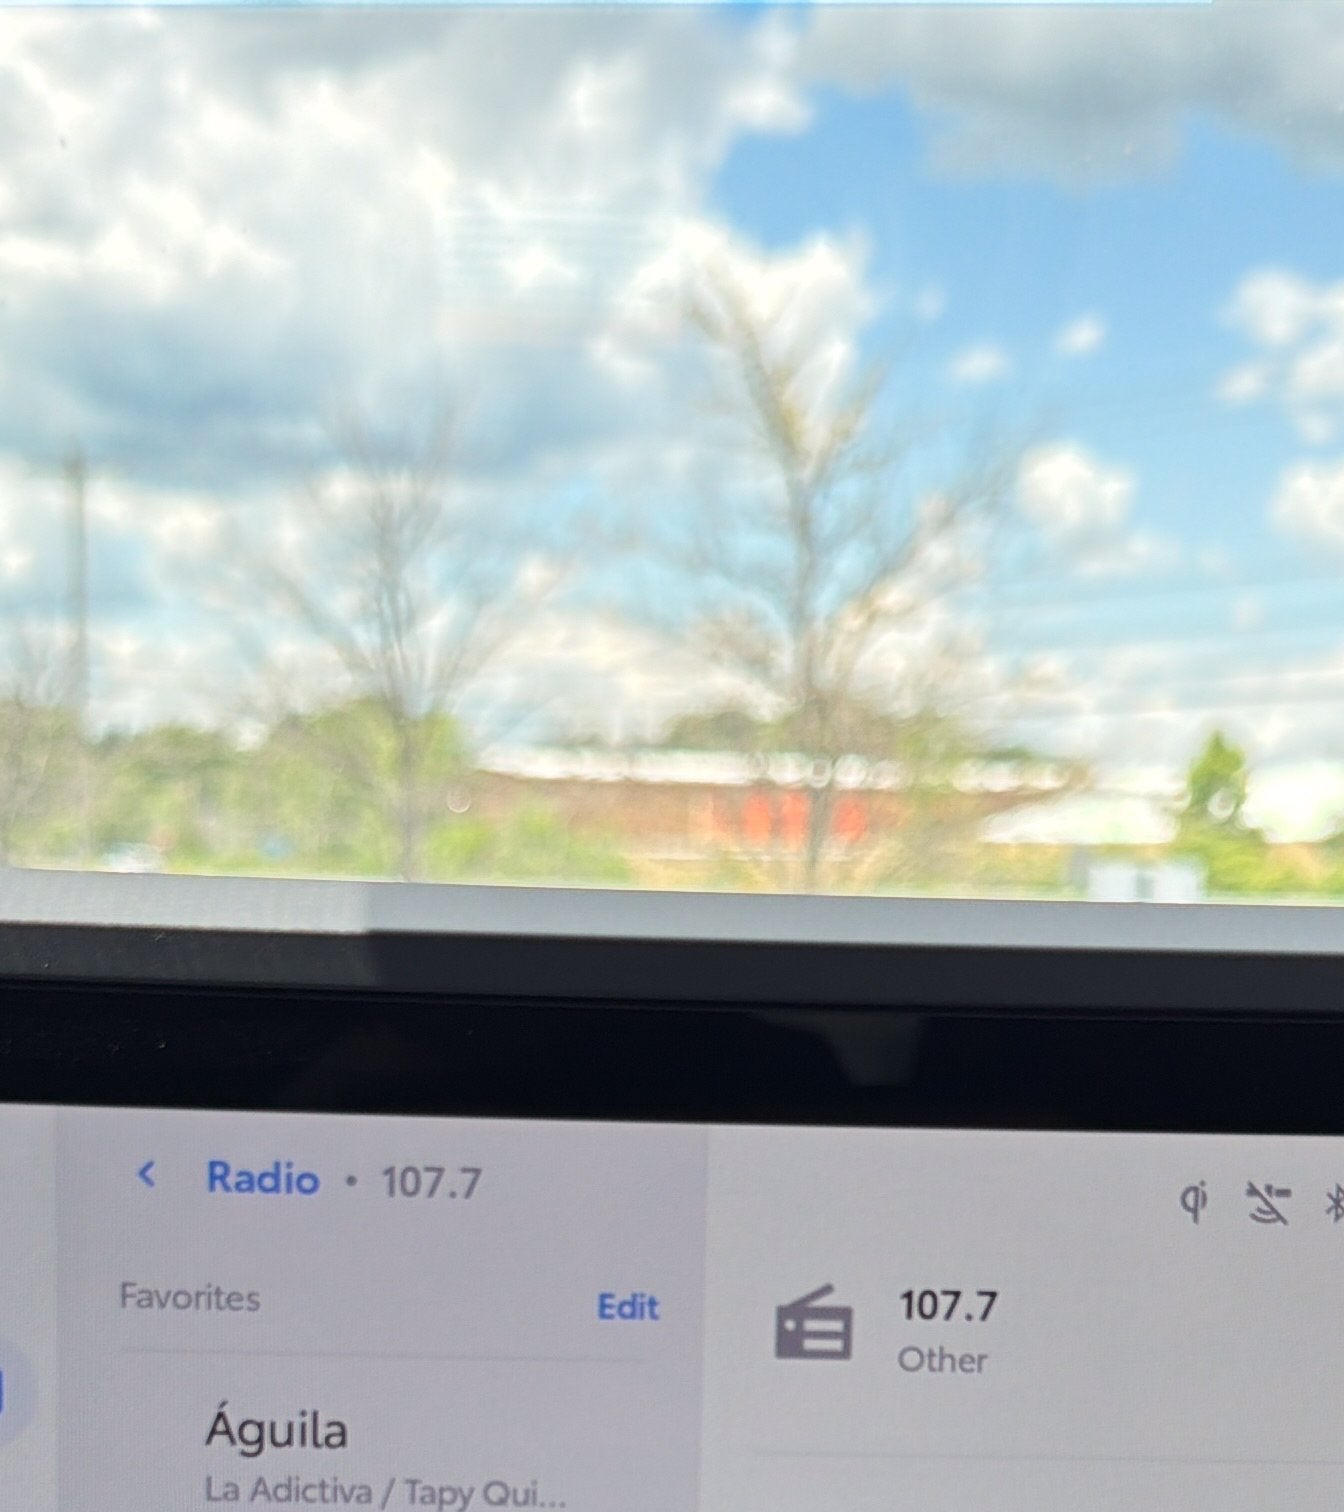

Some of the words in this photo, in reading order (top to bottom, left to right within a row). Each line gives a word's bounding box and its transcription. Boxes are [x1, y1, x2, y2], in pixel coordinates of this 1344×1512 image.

[207, 1159, 321, 1195] Radio
[382, 1166, 483, 1200] 107.7
[120, 1282, 261, 1312] Favorites
[598, 1291, 660, 1321] Edit
[899, 1289, 998, 1322] 107.7
[898, 1345, 989, 1374] Other
[205, 1400, 348, 1457] Águila
[206, 1476, 240, 1502] La
[250, 1476, 373, 1505] Adictiva
[406, 1478, 475, 1512] Tapy
